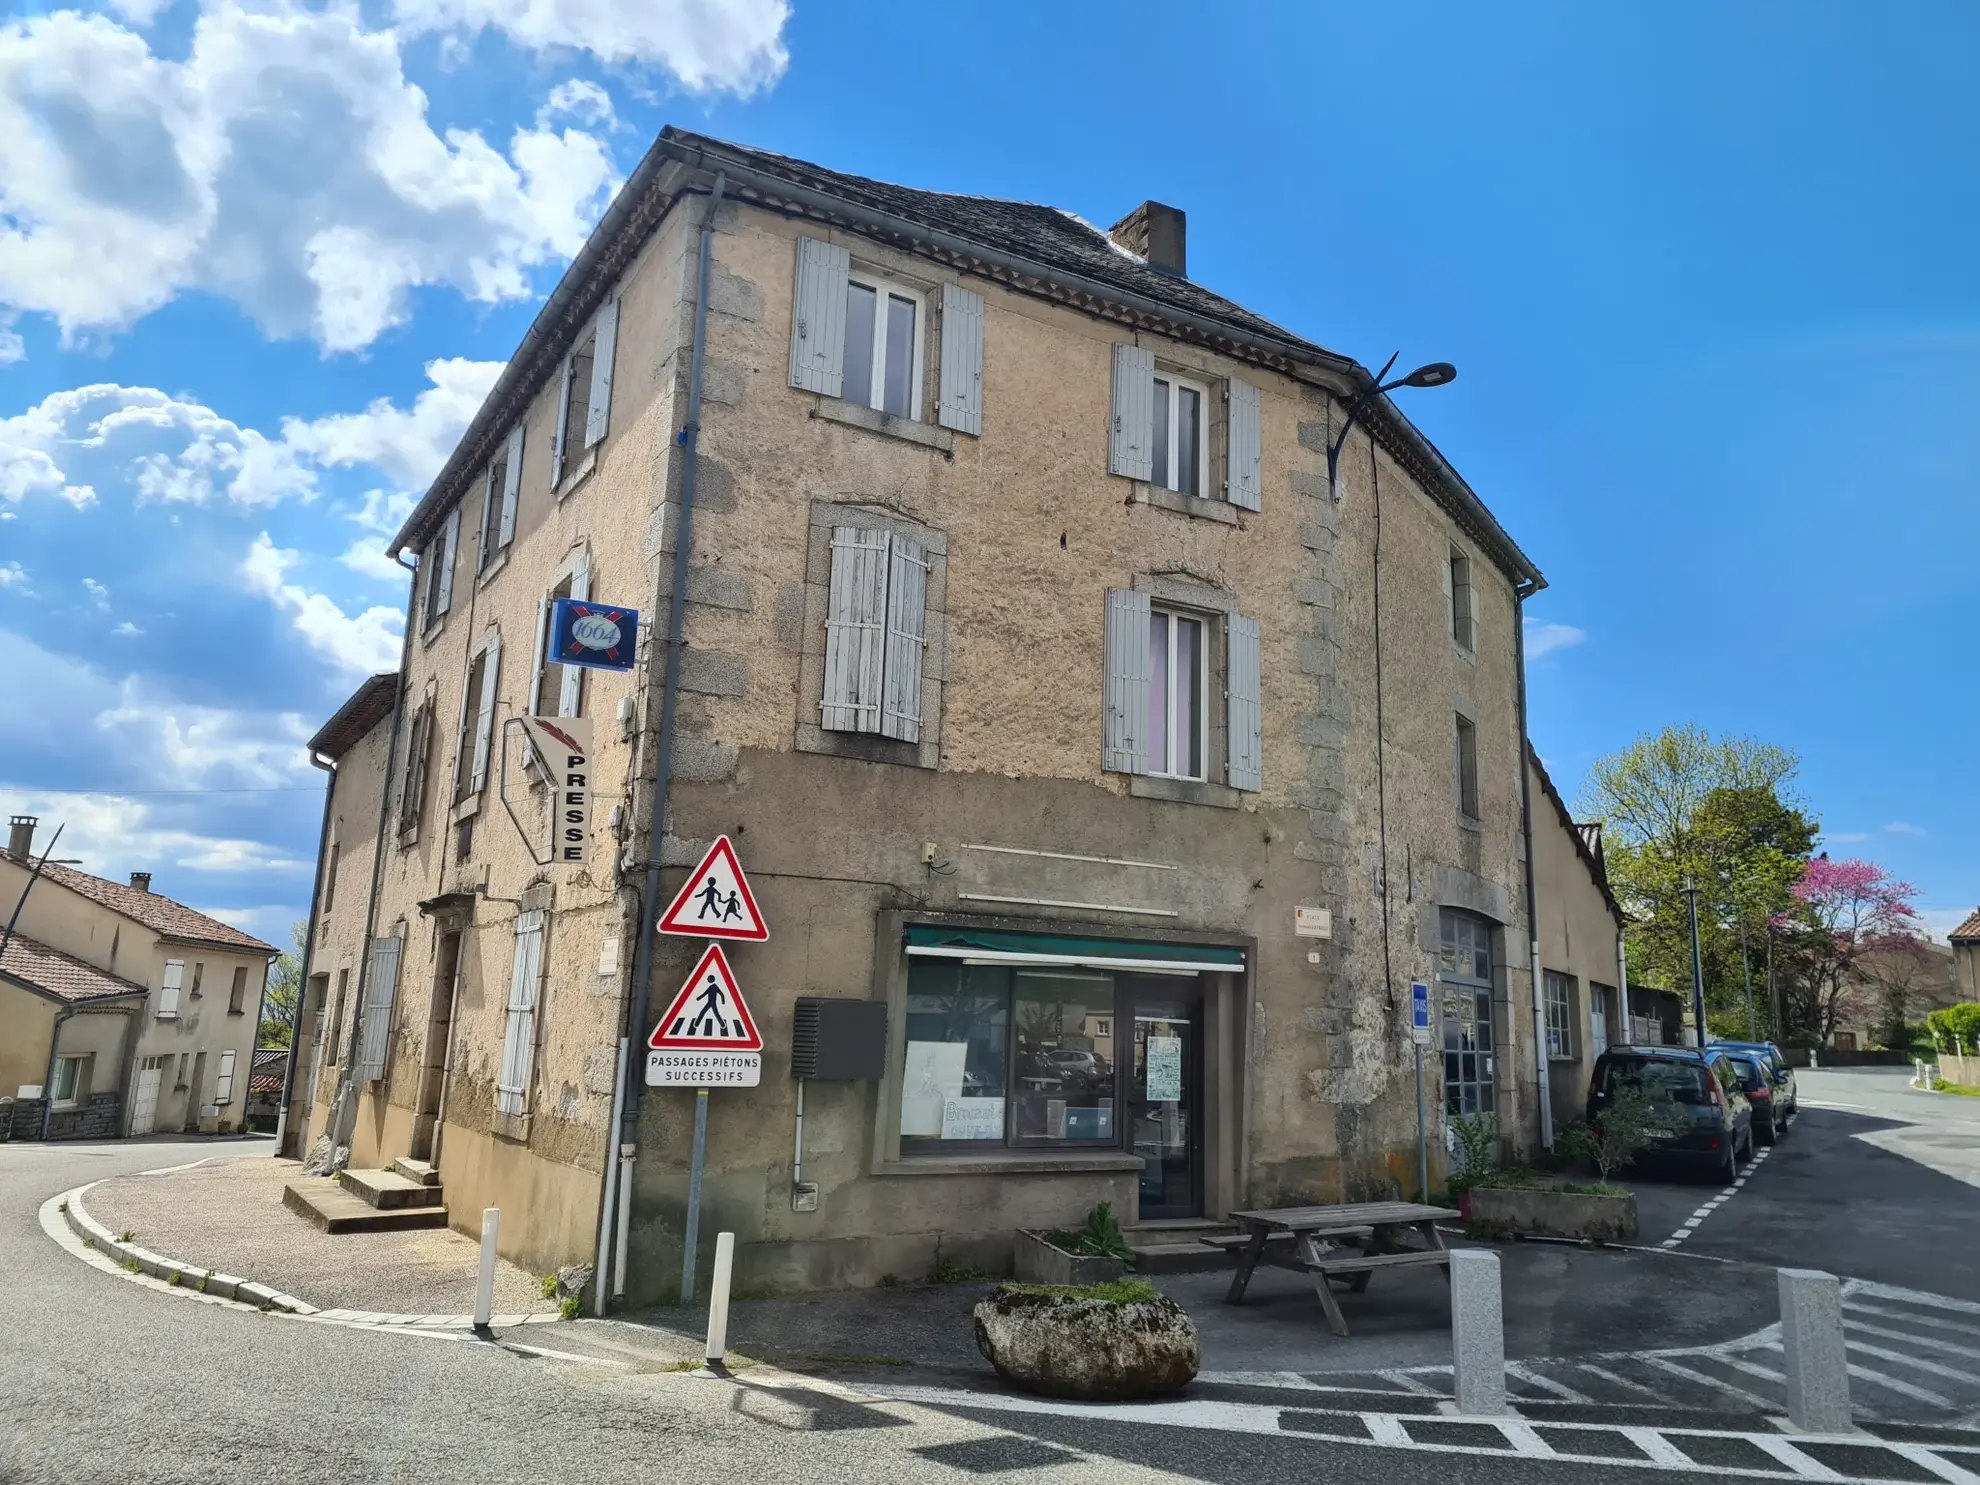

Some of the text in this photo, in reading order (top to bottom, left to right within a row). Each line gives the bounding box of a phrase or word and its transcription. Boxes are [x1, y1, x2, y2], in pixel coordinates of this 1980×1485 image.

[575, 619, 619, 645] 1664
[563, 755, 586, 861] PRESSE
[651, 1055, 758, 1068] PASSAGES PIÉTONS
[665, 1071, 743, 1081] SUCCESSIFS
